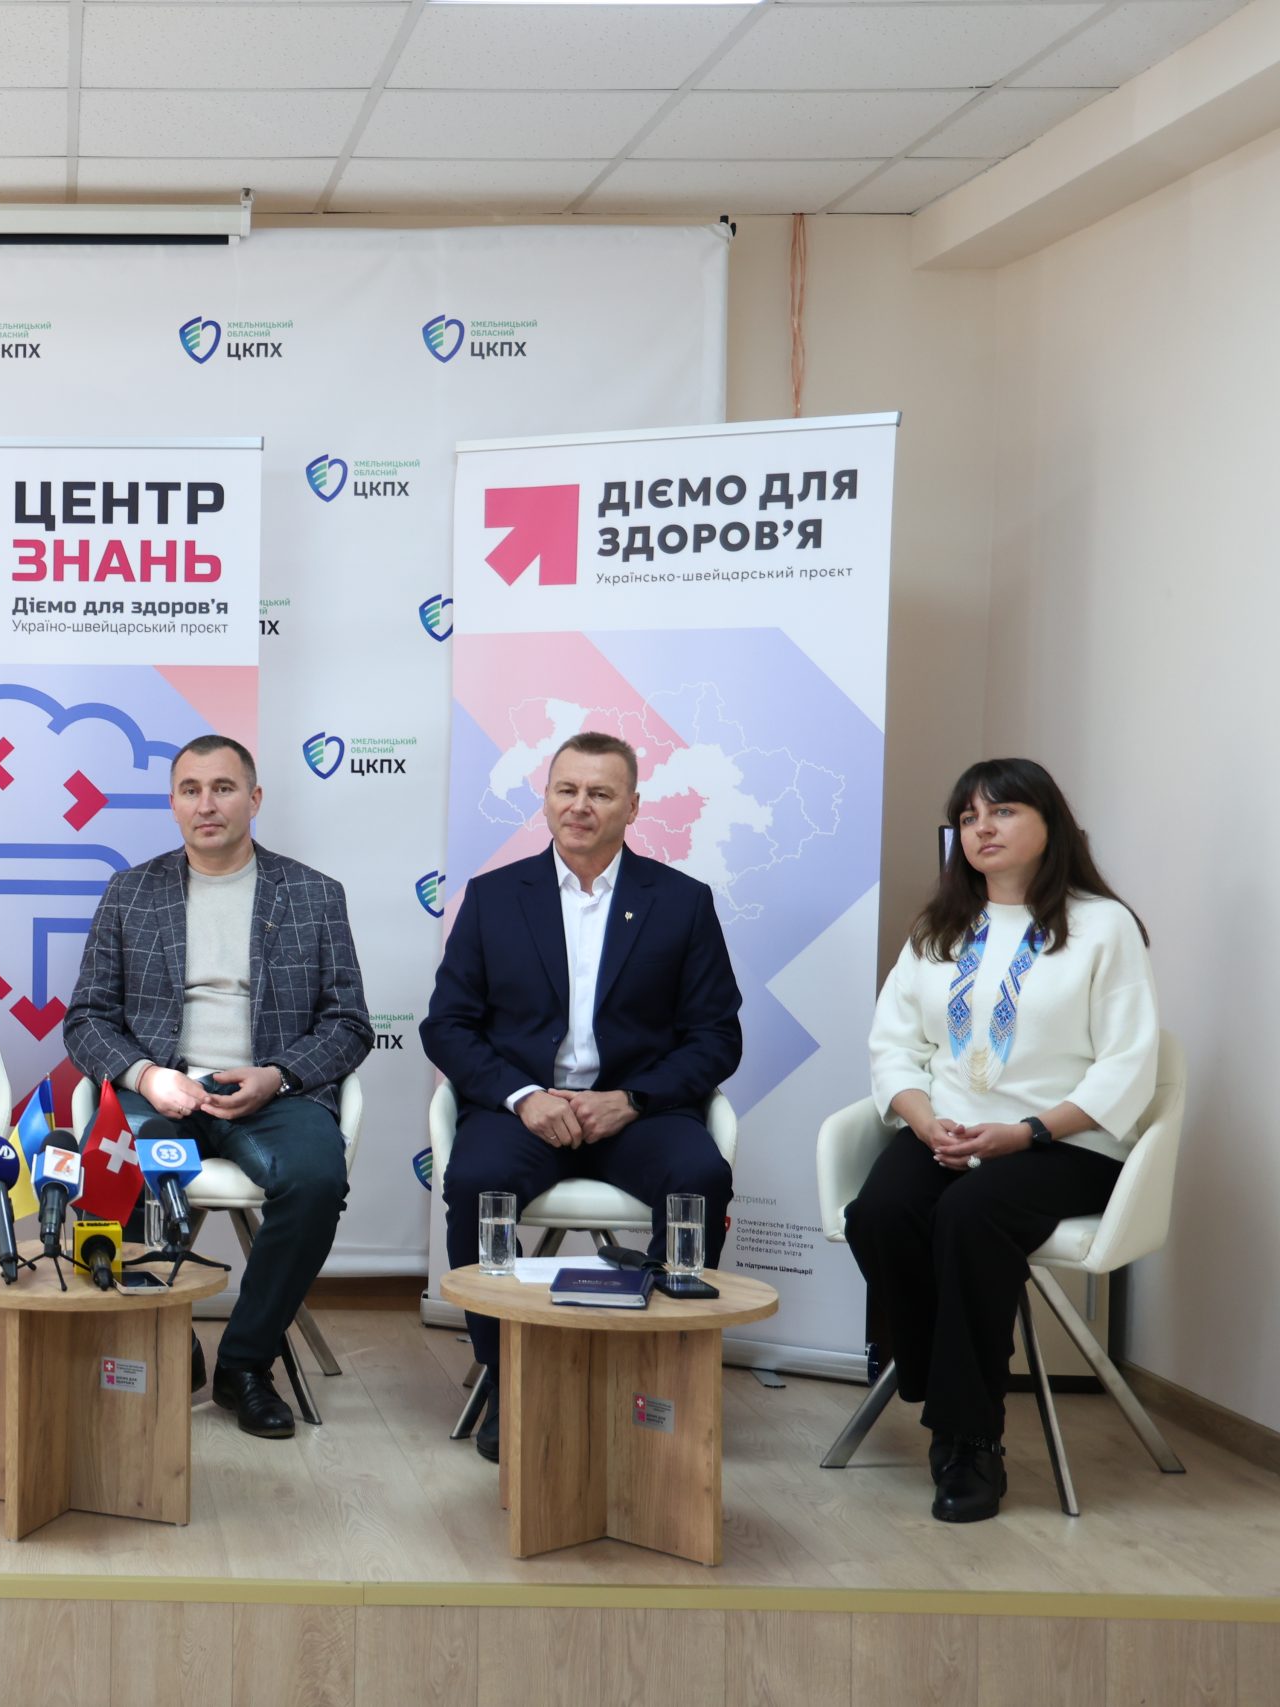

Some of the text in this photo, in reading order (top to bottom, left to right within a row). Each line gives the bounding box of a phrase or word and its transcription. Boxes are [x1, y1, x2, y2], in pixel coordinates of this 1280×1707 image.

[227, 320, 293, 329] ХМЕЛЬНИЦЬКИЙ
[470, 319, 537, 328] ХМЕЛЬНИЦЬКИЙ
[227, 343, 282, 360] ЦКПХ
[470, 342, 526, 359] ЦКПХ
[354, 459, 420, 468] ХМЕЛЬНИЦЬКИЙ
[354, 481, 409, 499] ЦКПХ
[597, 469, 858, 518] ДІЄМО ДЛЯ
[15, 481, 225, 531] ЦЕНТР
[597, 518, 822, 562] ЗДОРОВ’Я
[12, 539, 221, 583] ЗНАНЬ
[596, 566, 853, 586] Українсько-швейцарський проєкт
[12, 597, 76, 616] Діємо
[83, 600, 124, 616] для
[12, 619, 228, 637] Україно-швейцарський проєкт
[351, 736, 417, 745] ХМЕЛЬНИЦЬКИЙ
[351, 746, 394, 754] ОБЛАСНИЙ
[351, 759, 406, 776] ЦКПХ
[373, 1034, 404, 1050] ПХ
[159, 1148, 179, 1160] 33
[734, 1194, 777, 1206] дтримки
[737, 1218, 823, 1232] Schweizerische Eidgenosse
[784, 1232, 803, 1240] suisse
[788, 1241, 814, 1249] Svizzera
[744, 1262, 778, 1272] підтримки
